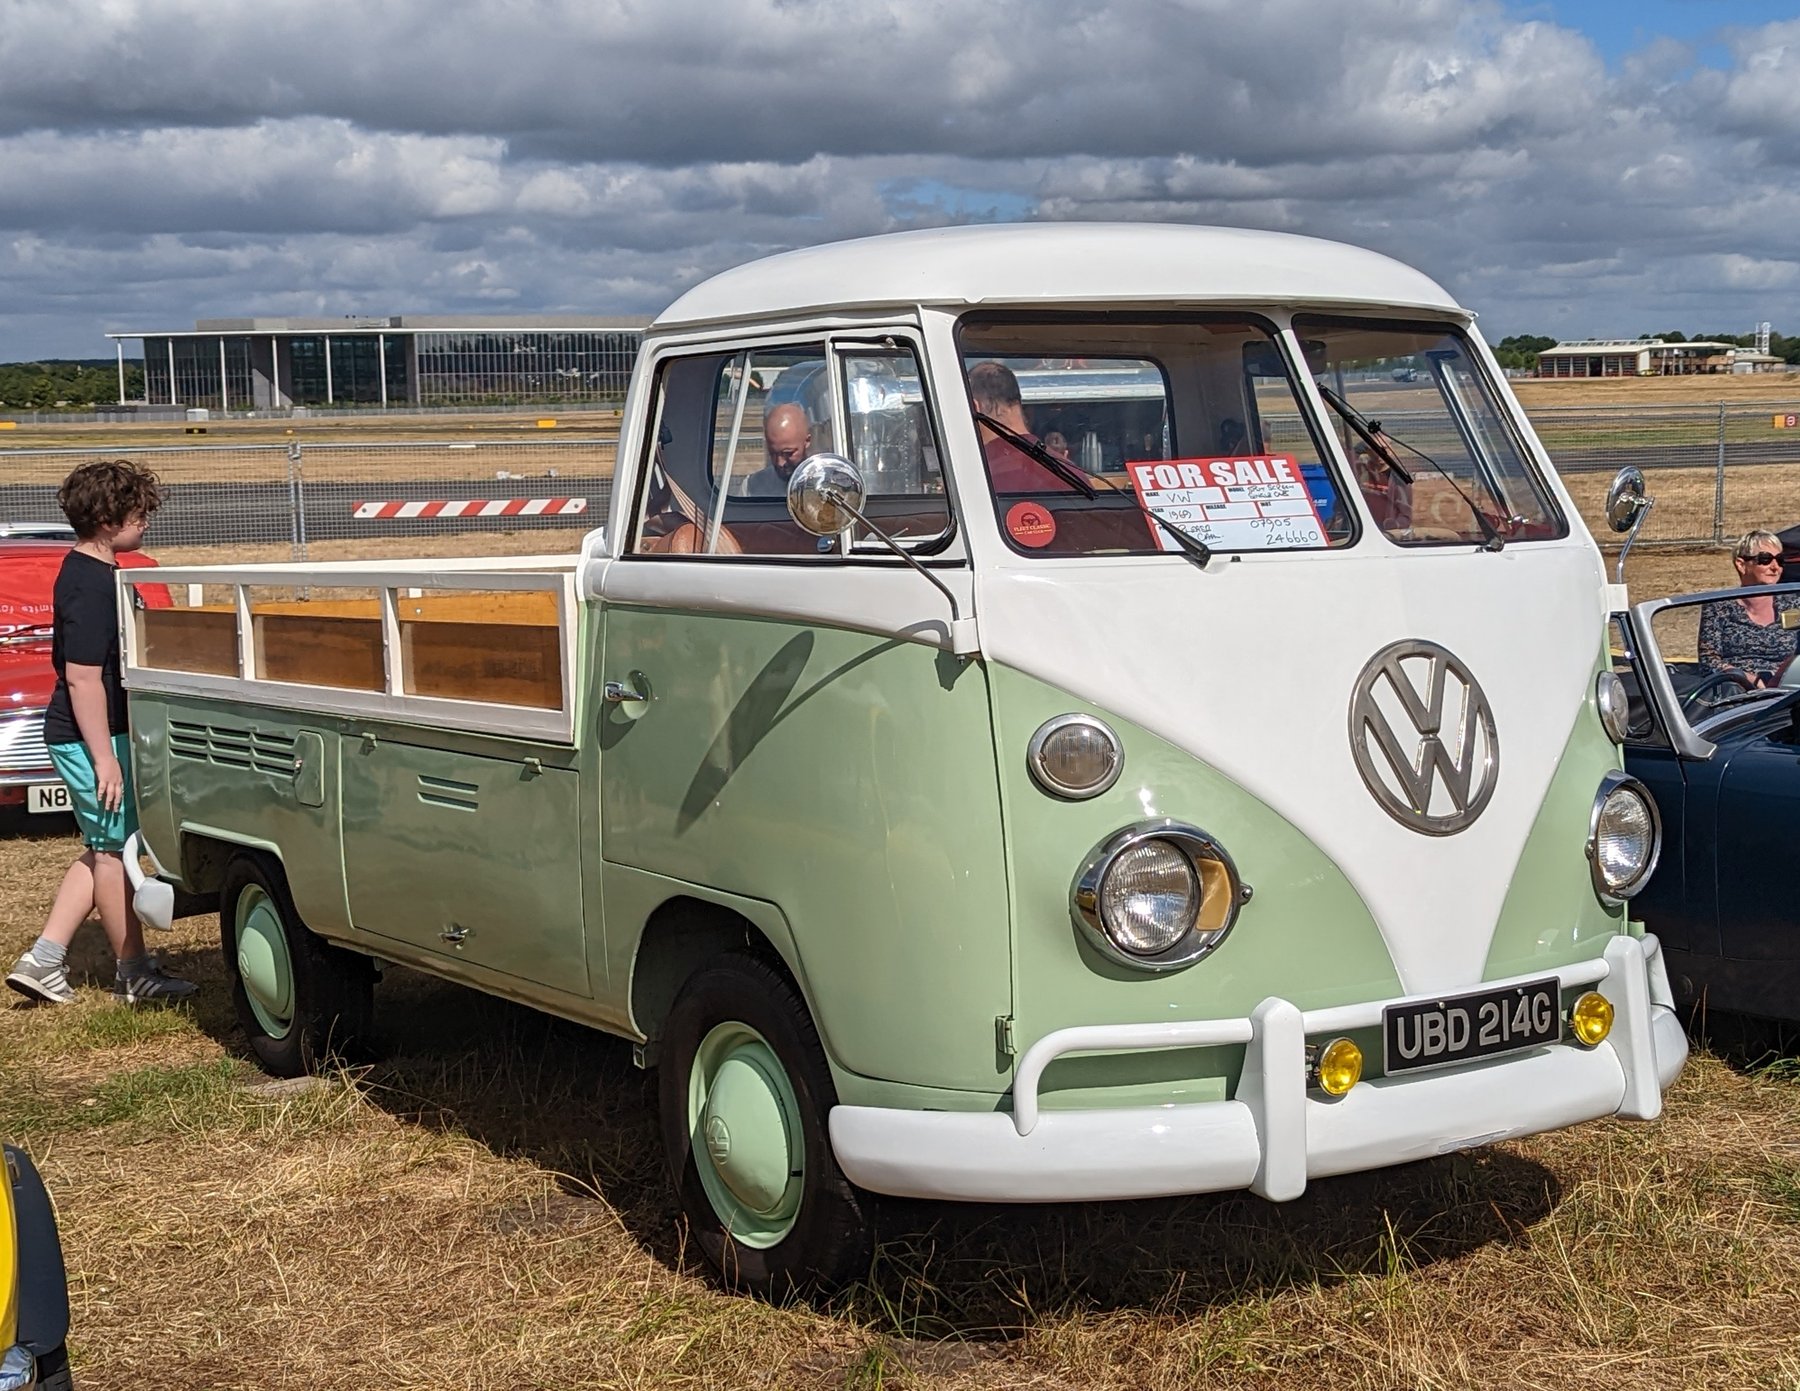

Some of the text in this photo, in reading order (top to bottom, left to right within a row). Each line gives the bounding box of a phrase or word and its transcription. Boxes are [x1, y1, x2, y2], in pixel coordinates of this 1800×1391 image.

[1134, 459, 1296, 490] FOR SALE
[1166, 491, 1194, 503] VW
[1168, 510, 1192, 520] 1969
[1250, 517, 1291, 532] 07905
[1266, 530, 1318, 545] 246660
[1348, 638, 1500, 837] VW
[40, 788, 73, 808] N8
[1397, 991, 1551, 1060] UBD 214G
